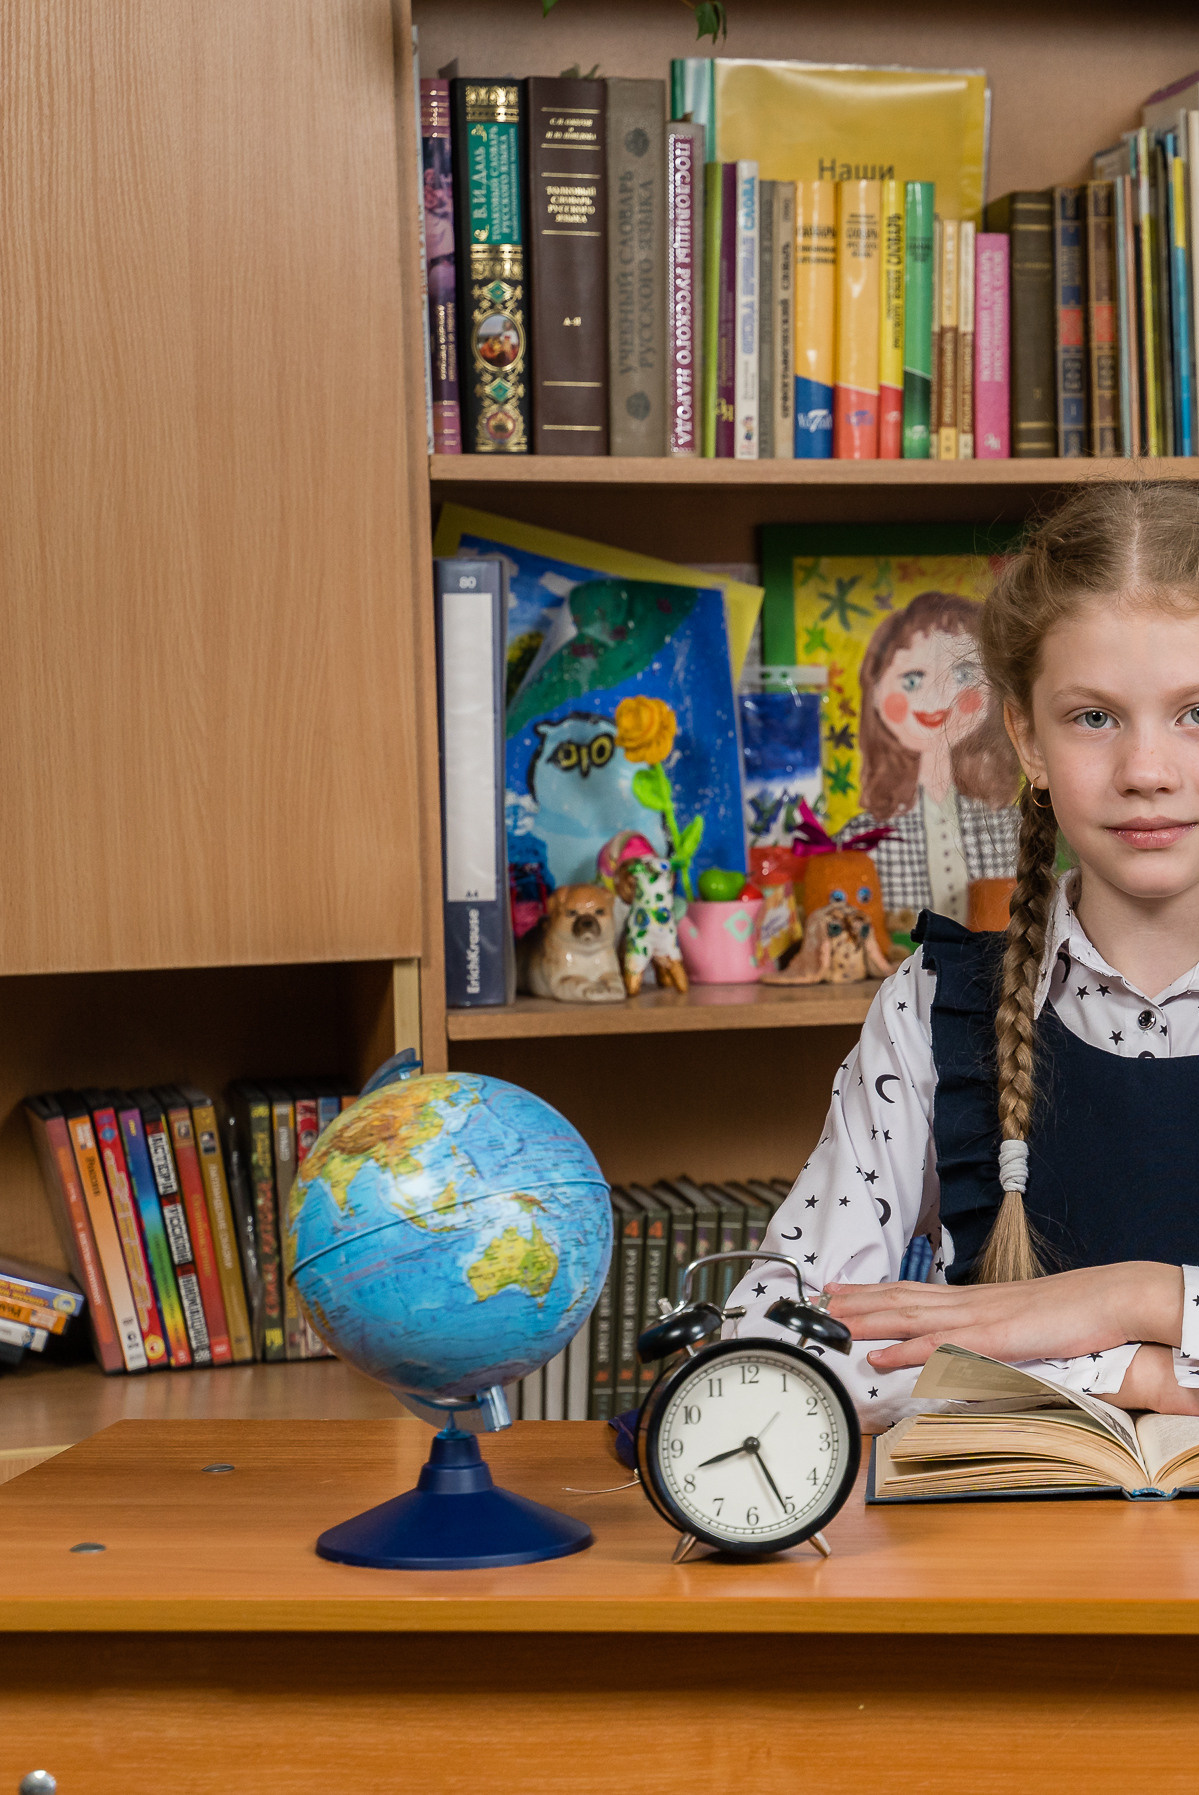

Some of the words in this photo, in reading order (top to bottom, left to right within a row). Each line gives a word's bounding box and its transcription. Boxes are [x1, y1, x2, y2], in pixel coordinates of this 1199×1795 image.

[489, 125, 500, 177] СЛОВАРЬ
[817, 157, 895, 181] Наши
[499, 173, 512, 234] РУССКОГО
[547, 204, 596, 214] РУССКОГО
[675, 142, 691, 264] ПОСЛОВИЦЫ
[618, 170, 635, 266] СЛОВАРЬ
[638, 179, 653, 250] ЯЗЫКА
[617, 271, 637, 374] УЧЕБНЫЙ
[638, 257, 654, 369] РУССКОГО
[675, 266, 692, 366] РУССКОГО
[674, 367, 693, 446] НАРОДА
[459, 576, 477, 589] 80
[466, 908, 480, 994] ErichKrause
[624, 1220, 639, 1238] 4
[649, 1220, 663, 1238] 4
[625, 1249, 637, 1316] РУССКИЙ
[649, 1249, 662, 1316] РУССКИЙ
[740, 1365, 760, 1385] 12
[781, 1374, 788, 1393] 1
[707, 1378, 724, 1398] 11
[683, 1405, 702, 1425] 10
[806, 1397, 818, 1416] 2
[671, 1439, 683, 1459] 9
[819, 1433, 831, 1452] 3
[683, 1474, 696, 1494] 8
[806, 1468, 820, 1486] 4
[712, 1498, 725, 1517] 7
[784, 1496, 796, 1515] 5
[747, 1507, 760, 1526] 6
